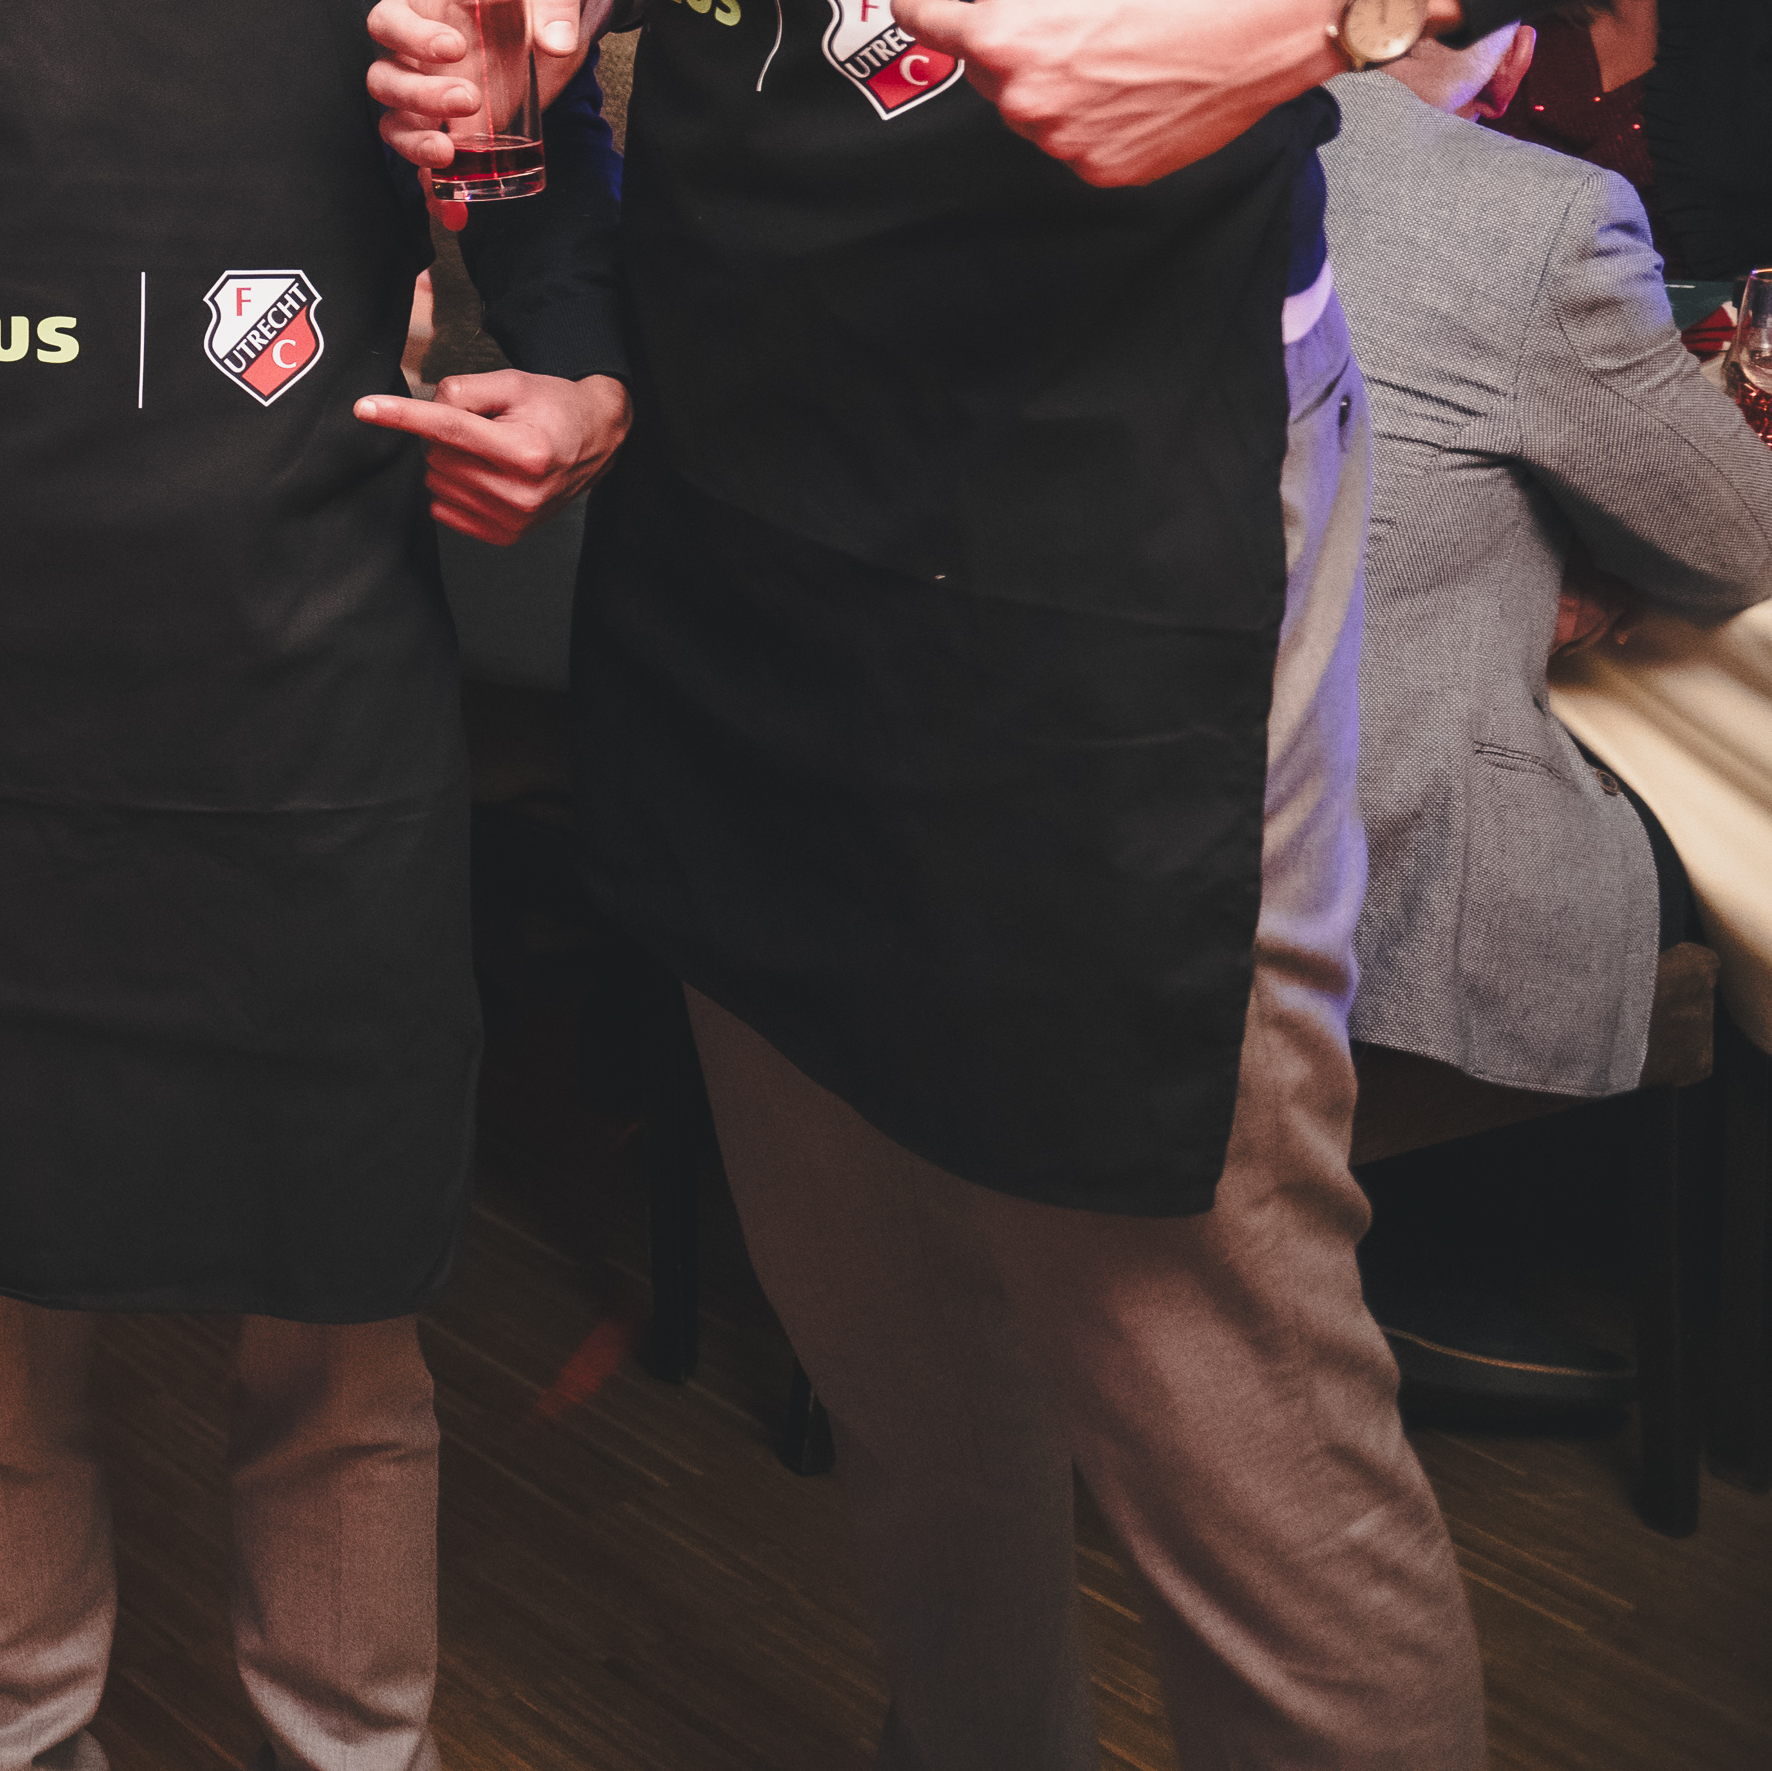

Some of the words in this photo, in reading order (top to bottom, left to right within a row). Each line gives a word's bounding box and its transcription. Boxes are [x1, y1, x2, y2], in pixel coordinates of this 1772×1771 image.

[844, 27, 916, 78] UTRE
[899, 54, 930, 86] C
[236, 287, 252, 316] F
[223, 282, 308, 373] UTRECHT
[272, 339, 297, 369] C
